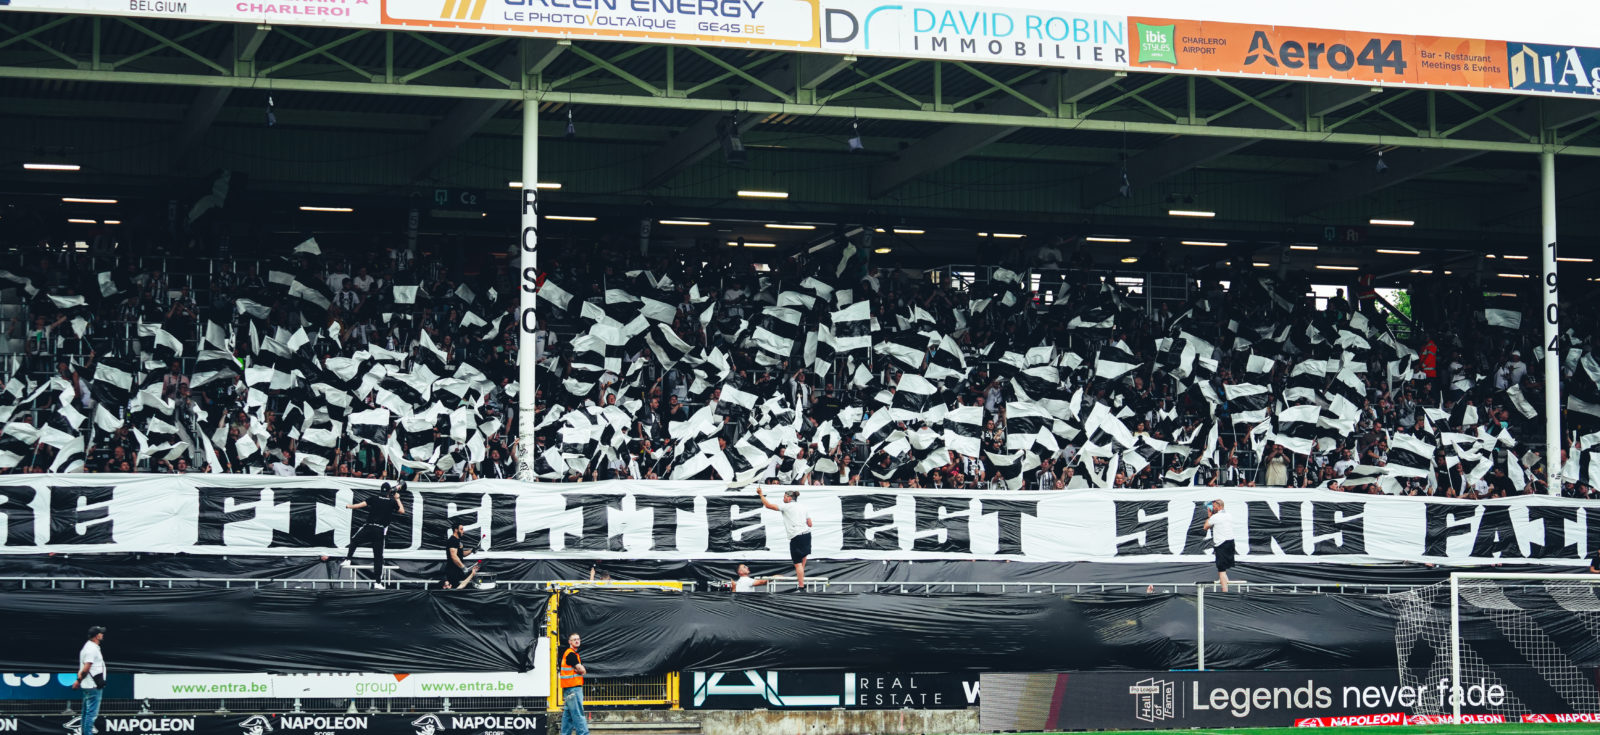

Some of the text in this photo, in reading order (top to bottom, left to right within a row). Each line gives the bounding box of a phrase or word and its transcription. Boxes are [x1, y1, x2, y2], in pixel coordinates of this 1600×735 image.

[130, 1, 187, 13] BELGIUM
[235, 3, 350, 16] CHARLEROI
[630, 0, 763, 19] ENERGY
[504, 11, 524, 21] LE
[913, 8, 1014, 38] DAVID
[1025, 15, 1124, 45] ROBIN
[1145, 30, 1167, 43] ibis
[1182, 36, 1226, 46] CHARLEROI
[914, 35, 1127, 63] IMMOBILIER
[1182, 46, 1216, 55] AIRPORT
[1243, 30, 1407, 75] Aero44
[1420, 50, 1436, 59] Bar
[1444, 52, 1492, 63] Restaurant
[1421, 60, 1501, 74] Meetings & Events
[1546, 242, 1559, 356] 1904
[838, 494, 1040, 556] EST
[1421, 502, 1600, 559] FAI
[172, 681, 269, 693] www.entra.be
[355, 682, 398, 696] group
[421, 680, 514, 692] www.entra.be
[860, 677, 918, 689] REAL
[860, 693, 942, 706] ESTATE
[1164, 687, 1172, 714] Fame
[1193, 677, 1504, 718] Legends never fade
[1142, 695, 1151, 718] Hall
[105, 718, 195, 732] NAPOLEON
[281, 716, 368, 730] NAPOLEON
[452, 716, 537, 730] NAPOLEON
[1330, 713, 1400, 727] NAPOLEON
[1437, 714, 1503, 724] NAOLEON
